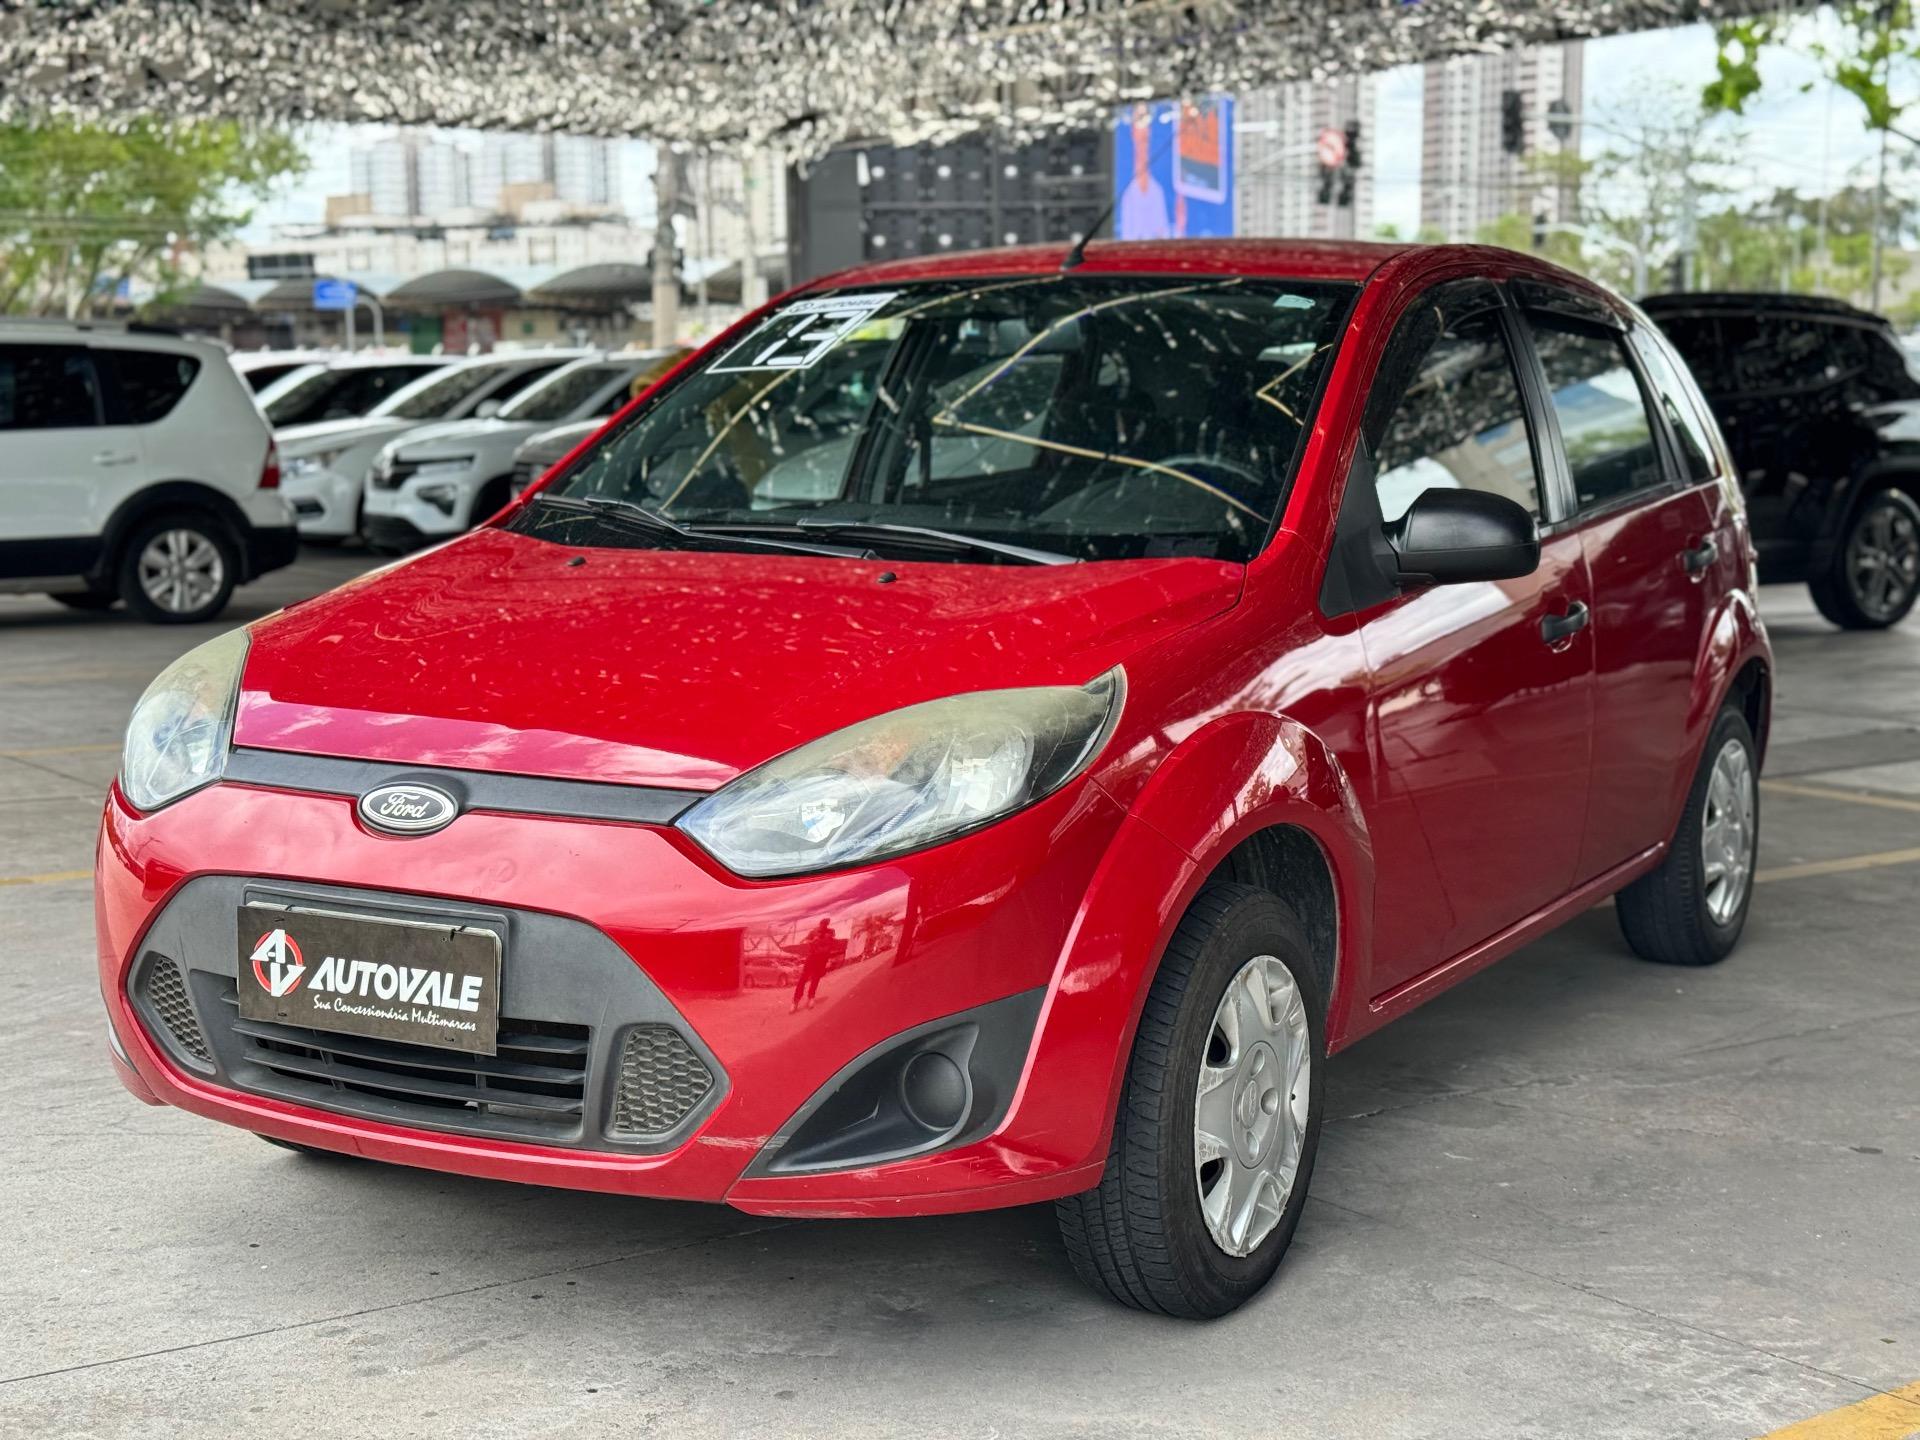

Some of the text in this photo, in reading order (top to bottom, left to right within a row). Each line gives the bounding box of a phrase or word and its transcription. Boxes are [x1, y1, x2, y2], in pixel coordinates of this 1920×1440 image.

[752, 310, 868, 366] 13
[380, 792, 430, 818] Ford
[307, 956, 483, 1013] AUTOVALE
[313, 994, 477, 1032] Sua Concessionária Multimarcas
